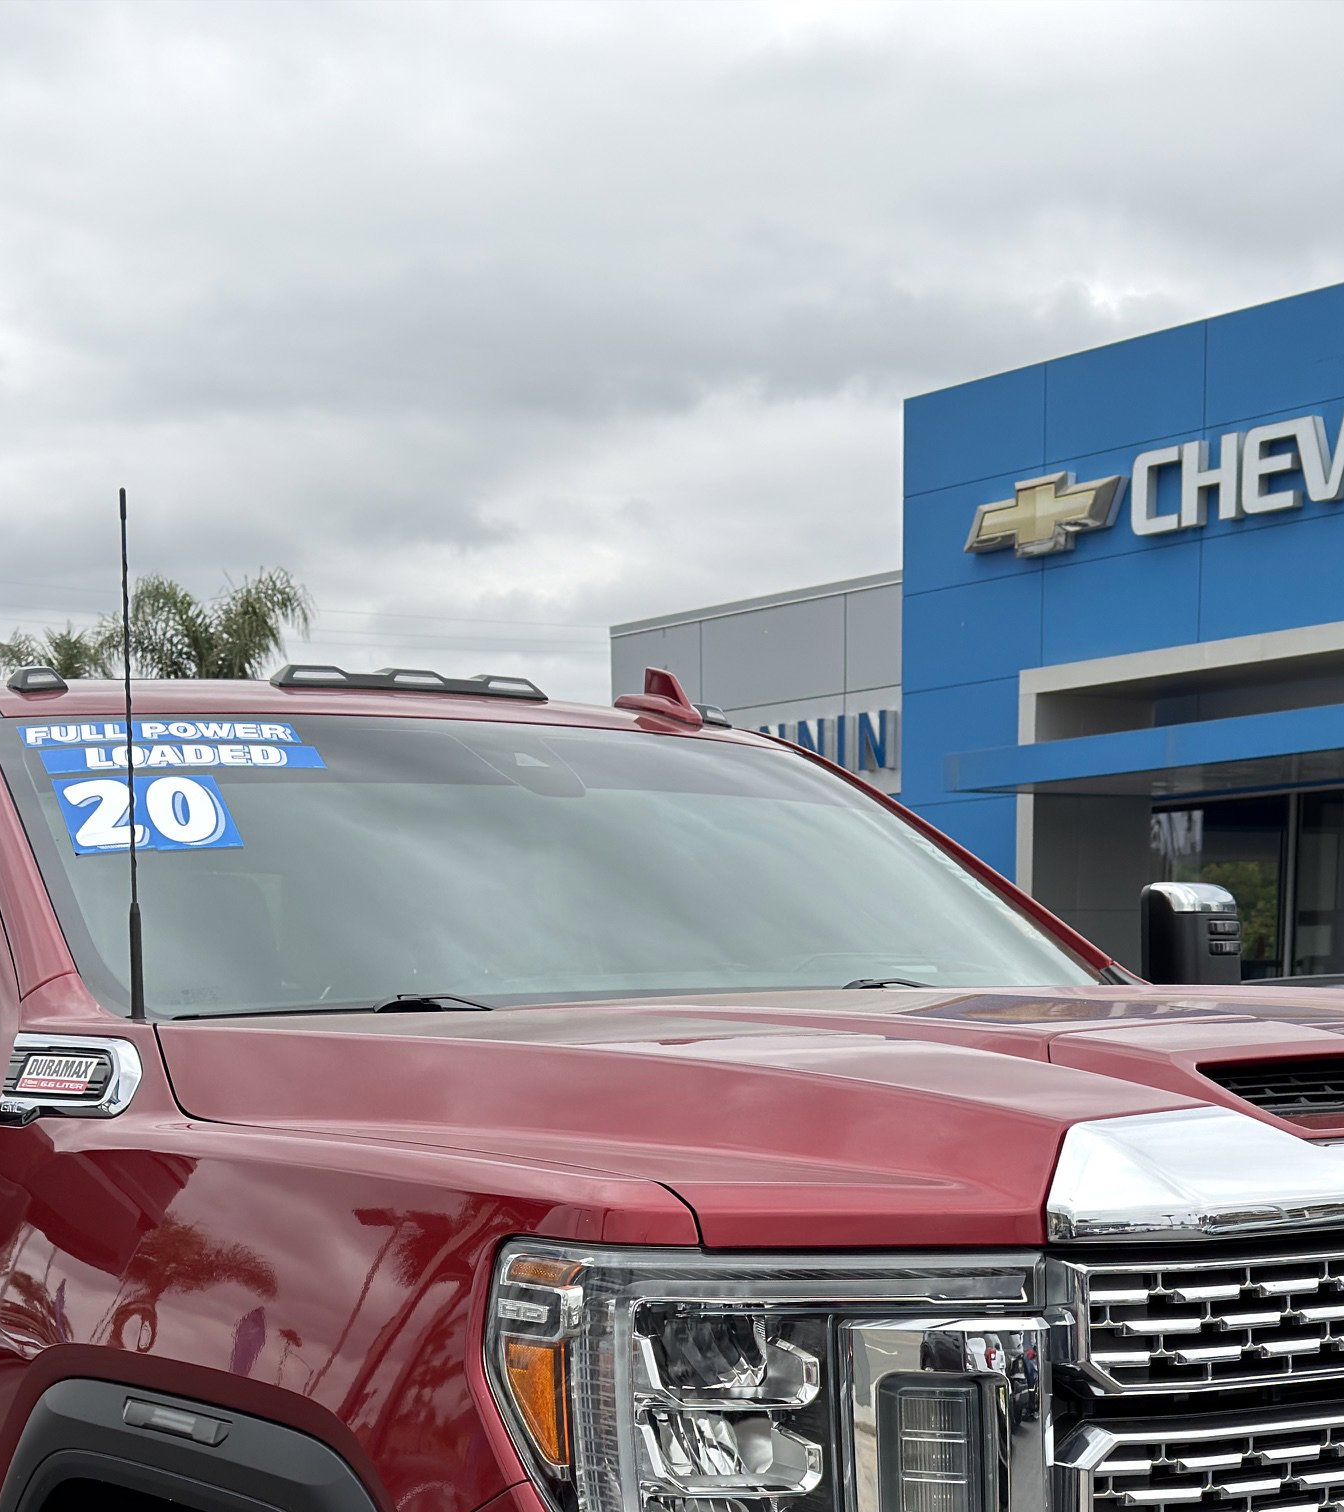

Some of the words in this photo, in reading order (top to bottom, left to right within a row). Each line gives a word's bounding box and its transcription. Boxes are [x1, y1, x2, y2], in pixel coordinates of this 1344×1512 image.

[25, 722, 128, 744] FULL
[141, 721, 293, 741] POWER
[85, 745, 288, 769] LOADED
[62, 776, 226, 849] 20
[27, 1058, 94, 1079] DURAMAX
[40, 1080, 55, 1088] 6.6
[56, 1081, 84, 1090] LITER
